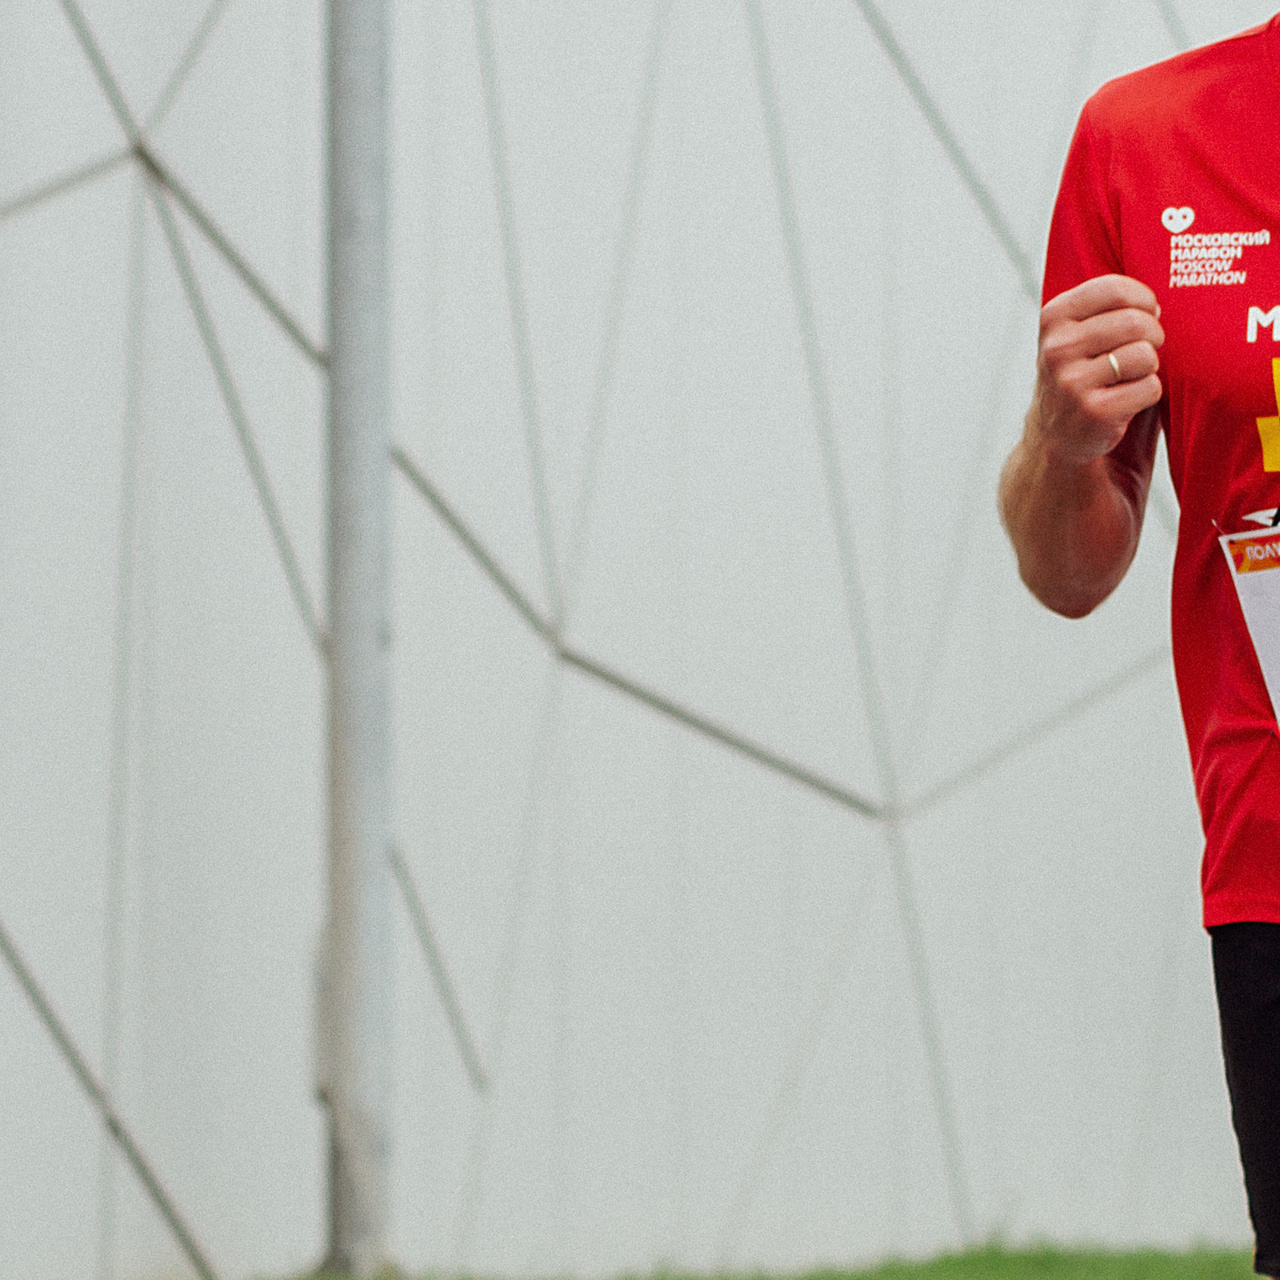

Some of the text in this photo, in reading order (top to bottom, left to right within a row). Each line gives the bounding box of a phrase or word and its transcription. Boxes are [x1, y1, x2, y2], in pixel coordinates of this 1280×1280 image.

[1170, 228, 1271, 248] МОСКОВСКИЙ
[1170, 246, 1242, 261] МАРАФОН
[1169, 260, 1233, 275] MOSCOW
[1168, 271, 1247, 289] MARATHON
